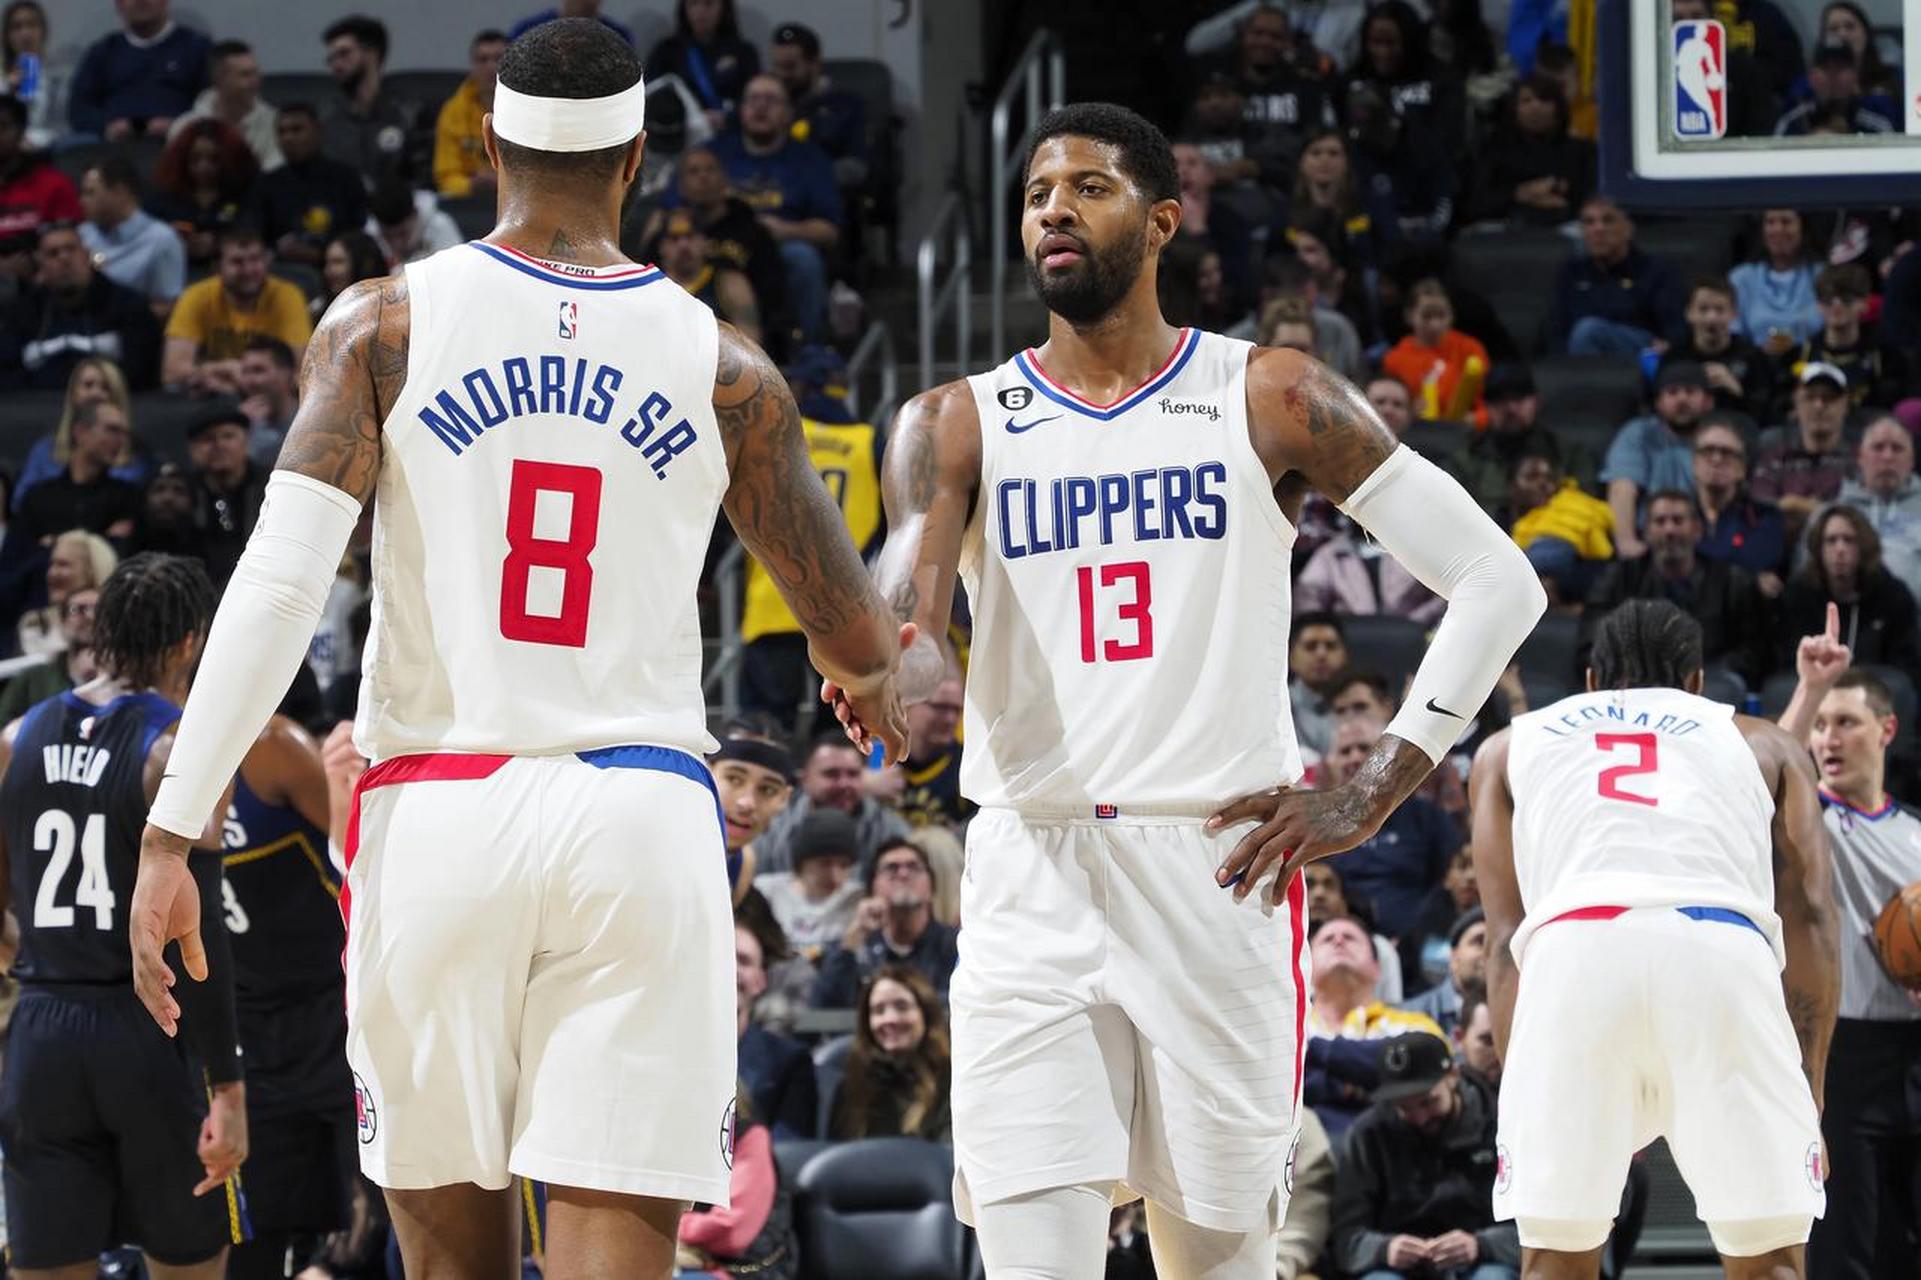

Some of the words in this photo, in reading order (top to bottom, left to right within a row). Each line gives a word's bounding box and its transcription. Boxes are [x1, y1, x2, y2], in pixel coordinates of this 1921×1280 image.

[418, 355, 623, 456] MORRIS
[621, 391, 697, 480] SR.
[1005, 388, 1026, 409] 6
[1158, 398, 1221, 421] honey
[500, 459, 602, 649] 8
[997, 461, 1227, 559] CLIPPERS
[1077, 561, 1153, 663] 13
[1543, 705, 1701, 737] LEONARD
[1595, 732, 1658, 807] 2
[33, 809, 116, 931] 24
